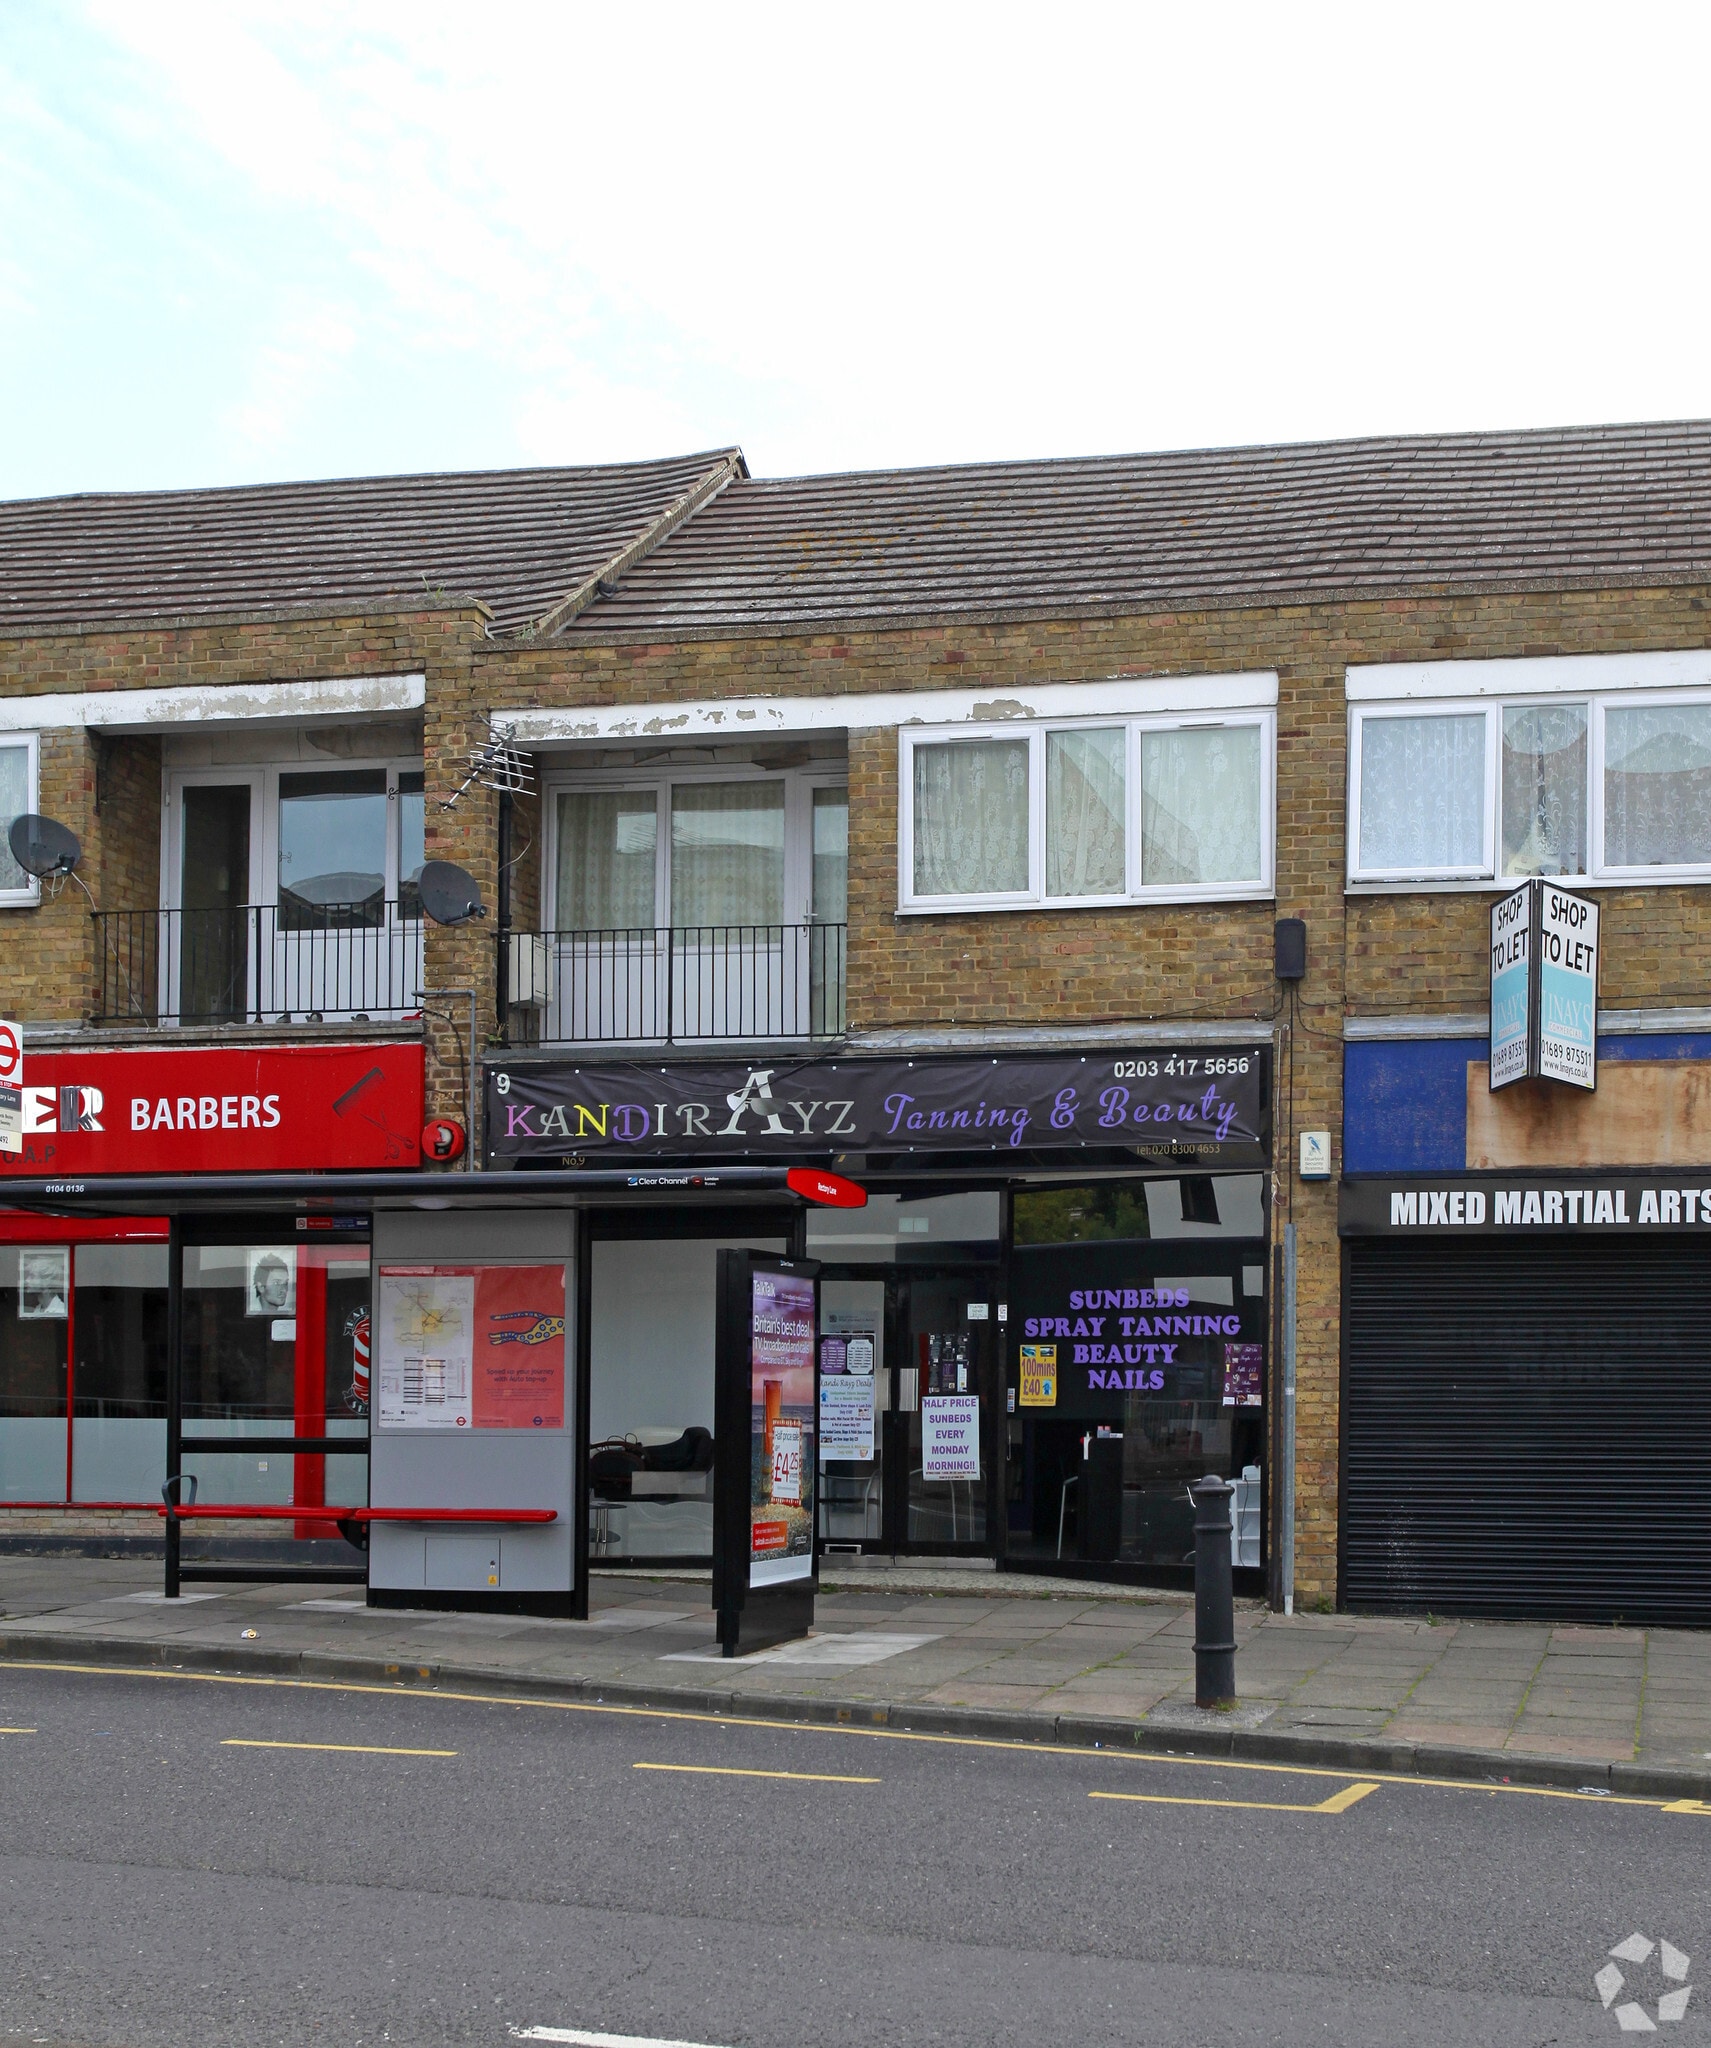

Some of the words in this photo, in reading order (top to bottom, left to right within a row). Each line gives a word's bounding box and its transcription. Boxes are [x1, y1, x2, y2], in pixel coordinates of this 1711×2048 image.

[1498, 894, 1523, 931] SHOP
[1550, 894, 1588, 930] SHOP
[1492, 943, 1504, 974] TO
[1506, 928, 1528, 965] LET
[1541, 930, 1561, 963] TO
[1565, 938, 1594, 974] LET
[1549, 1021, 1582, 1039] COMMERCIAL
[1493, 1047, 1507, 1068] 01689
[1541, 1039, 1563, 1059] 01689
[1566, 1046, 1592, 1067] 875511
[1113, 1059, 1159, 1078] 0203
[1164, 1058, 1198, 1077] 417
[1204, 1057, 1249, 1075] 5656
[1544, 1060, 1589, 1079] www.linays.co.uk
[496, 1073, 511, 1095] 9
[130, 1094, 282, 1132] BARBERS
[504, 1069, 856, 1142] KANDIRAYZ
[883, 1093, 1032, 1147] Tanning
[1050, 1087, 1080, 1129] &
[1098, 1084, 1239, 1141] Beauty
[1172, 1144, 1195, 1155] 8300
[1197, 1143, 1221, 1154] 4653
[45, 1185, 64, 1193] 0104
[66, 1184, 85, 1193] 0136
[639, 1177, 657, 1185] Clear
[658, 1177, 688, 1185] Channel
[1390, 1191, 1486, 1226] MIXED
[1494, 1190, 1629, 1225] MARTIAL
[1638, 1189, 1711, 1224] ARTS
[753, 1280, 776, 1297] TalkTalk
[1069, 1288, 1190, 1310] SUNBEDS
[754, 1315, 781, 1335] Britain's
[781, 1317, 796, 1337] best
[796, 1319, 810, 1338] deal
[1024, 1317, 1107, 1338] SPRAY
[1119, 1315, 1242, 1337] TANNING
[763, 1337, 791, 1353] broadband
[1073, 1343, 1179, 1364] BEAUTY
[1021, 1358, 1055, 1377] 100mins
[1023, 1378, 1040, 1396] £40
[1088, 1370, 1165, 1390] NAILS
[923, 1398, 948, 1408] HALF
[949, 1398, 977, 1408] PRICE
[929, 1413, 972, 1424] SUNBEDS
[935, 1429, 965, 1439] EVERY
[931, 1445, 970, 1455] MONDAY
[927, 1460, 975, 1471] MORNING!!
